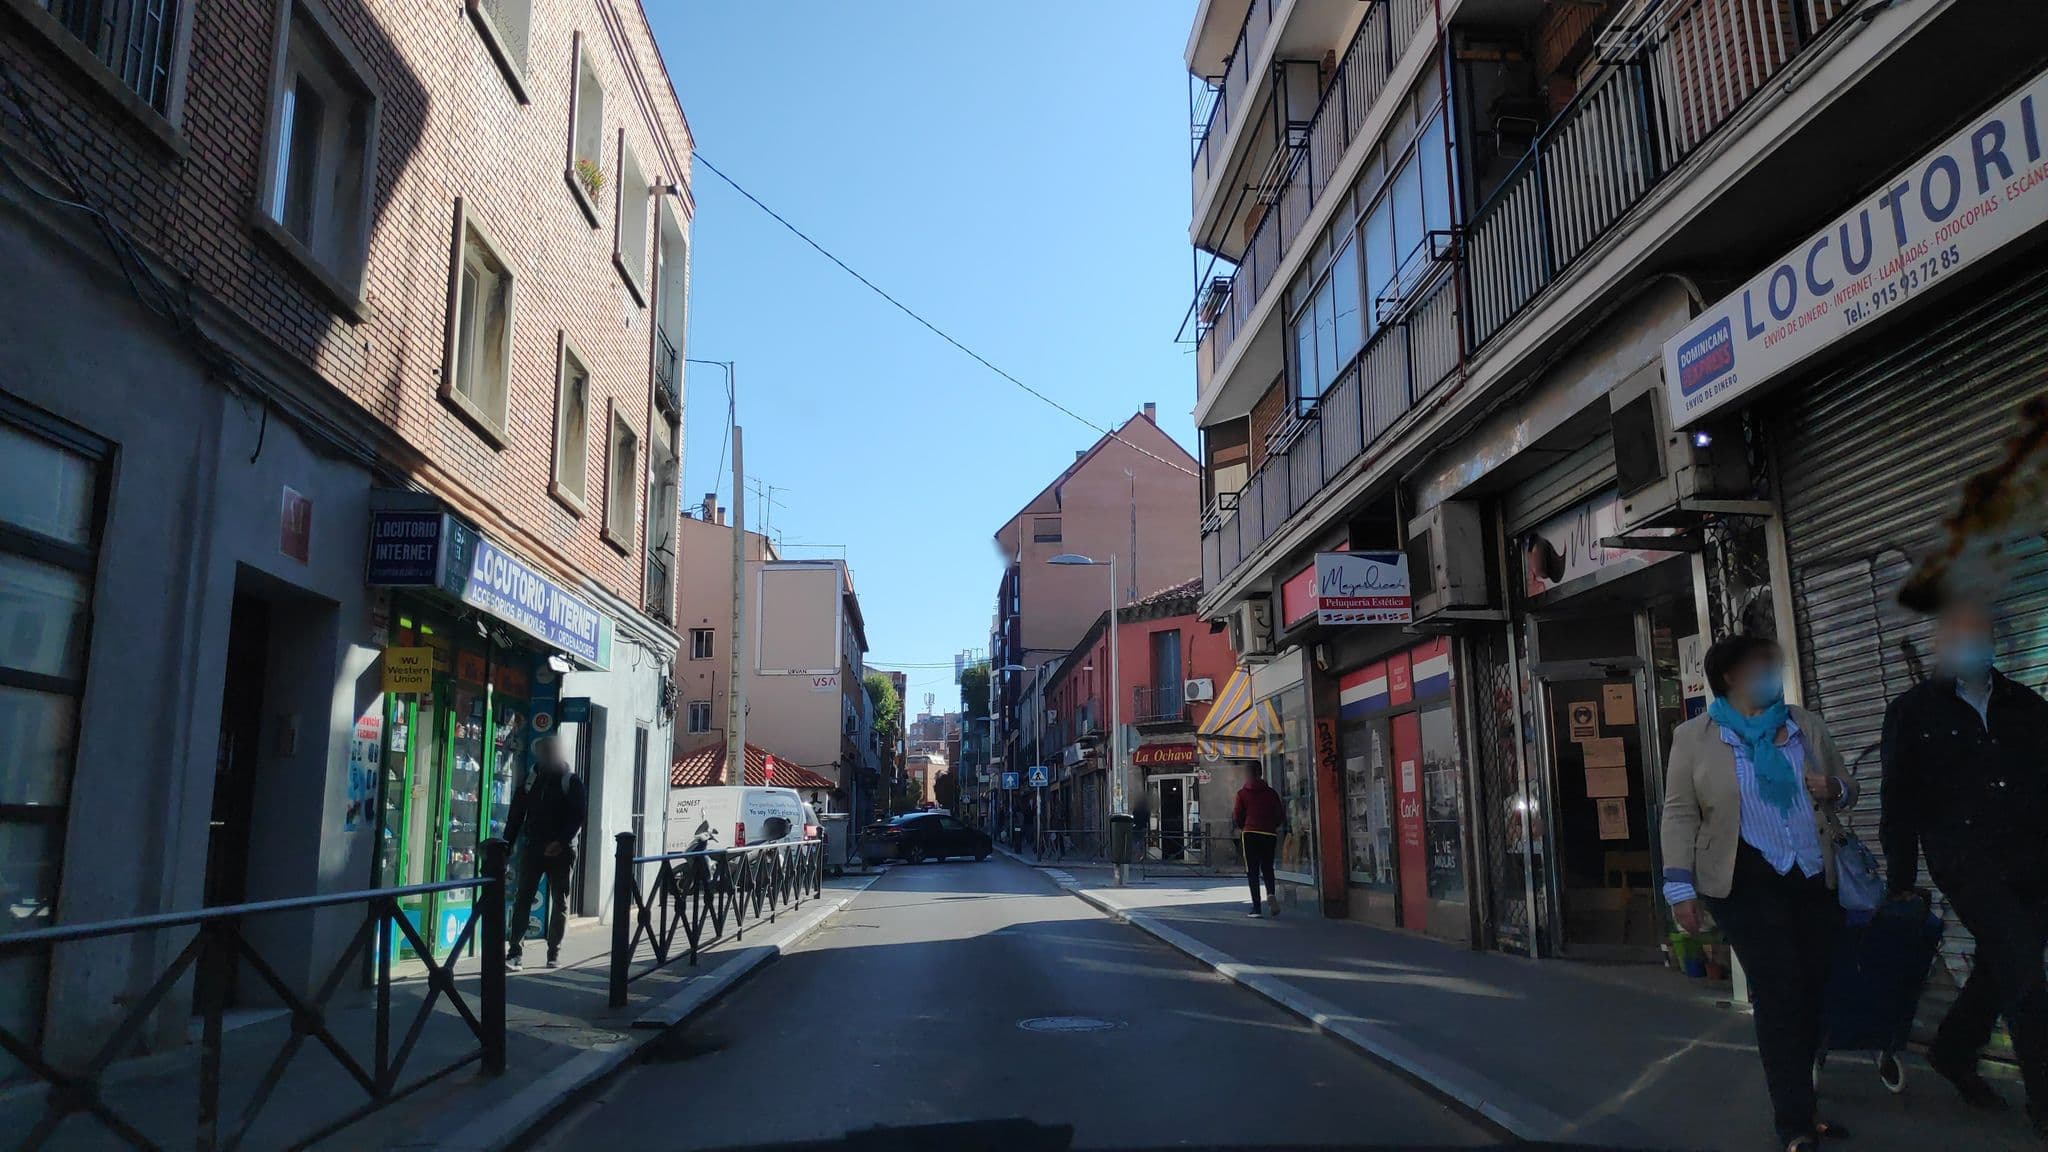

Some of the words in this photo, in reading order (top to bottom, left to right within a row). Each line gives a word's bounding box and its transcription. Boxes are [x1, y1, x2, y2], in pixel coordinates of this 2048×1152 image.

[1743, 94, 2040, 341] LOCUTORI
[1788, 321, 1798, 335] DE
[1798, 301, 1828, 329] DINERO
[1833, 273, 1873, 308] INTERNET
[1879, 240, 1930, 280] LLAMADAS
[1935, 195, 1999, 246] FOTOCOPIAS
[1843, 301, 1871, 326] Tel.:
[1872, 282, 1898, 309] 915
[1900, 270, 1919, 299] 93
[1920, 257, 1938, 282] 72
[1940, 244, 1960, 269] 85
[1681, 326, 1729, 368] DOMINICANA
[1705, 387, 1713, 398] DE
[1714, 374, 1738, 395] DINERO
[375, 520, 438, 539] LOCUTORIO
[375, 543, 434, 561] INTERNET
[473, 541, 546, 615] LOCUTORIO
[549, 588, 598, 643] INTERNET
[471, 585, 516, 620] ACCESORIOS
[549, 624, 556, 640] Y
[558, 629, 596, 659] ORDENADORES
[387, 665, 430, 675] Western
[401, 656, 418, 665] WU
[393, 674, 423, 683] Union
[812, 677, 837, 687] VSA
[1135, 752, 1149, 763] La
[1153, 748, 1193, 763] Ochava
